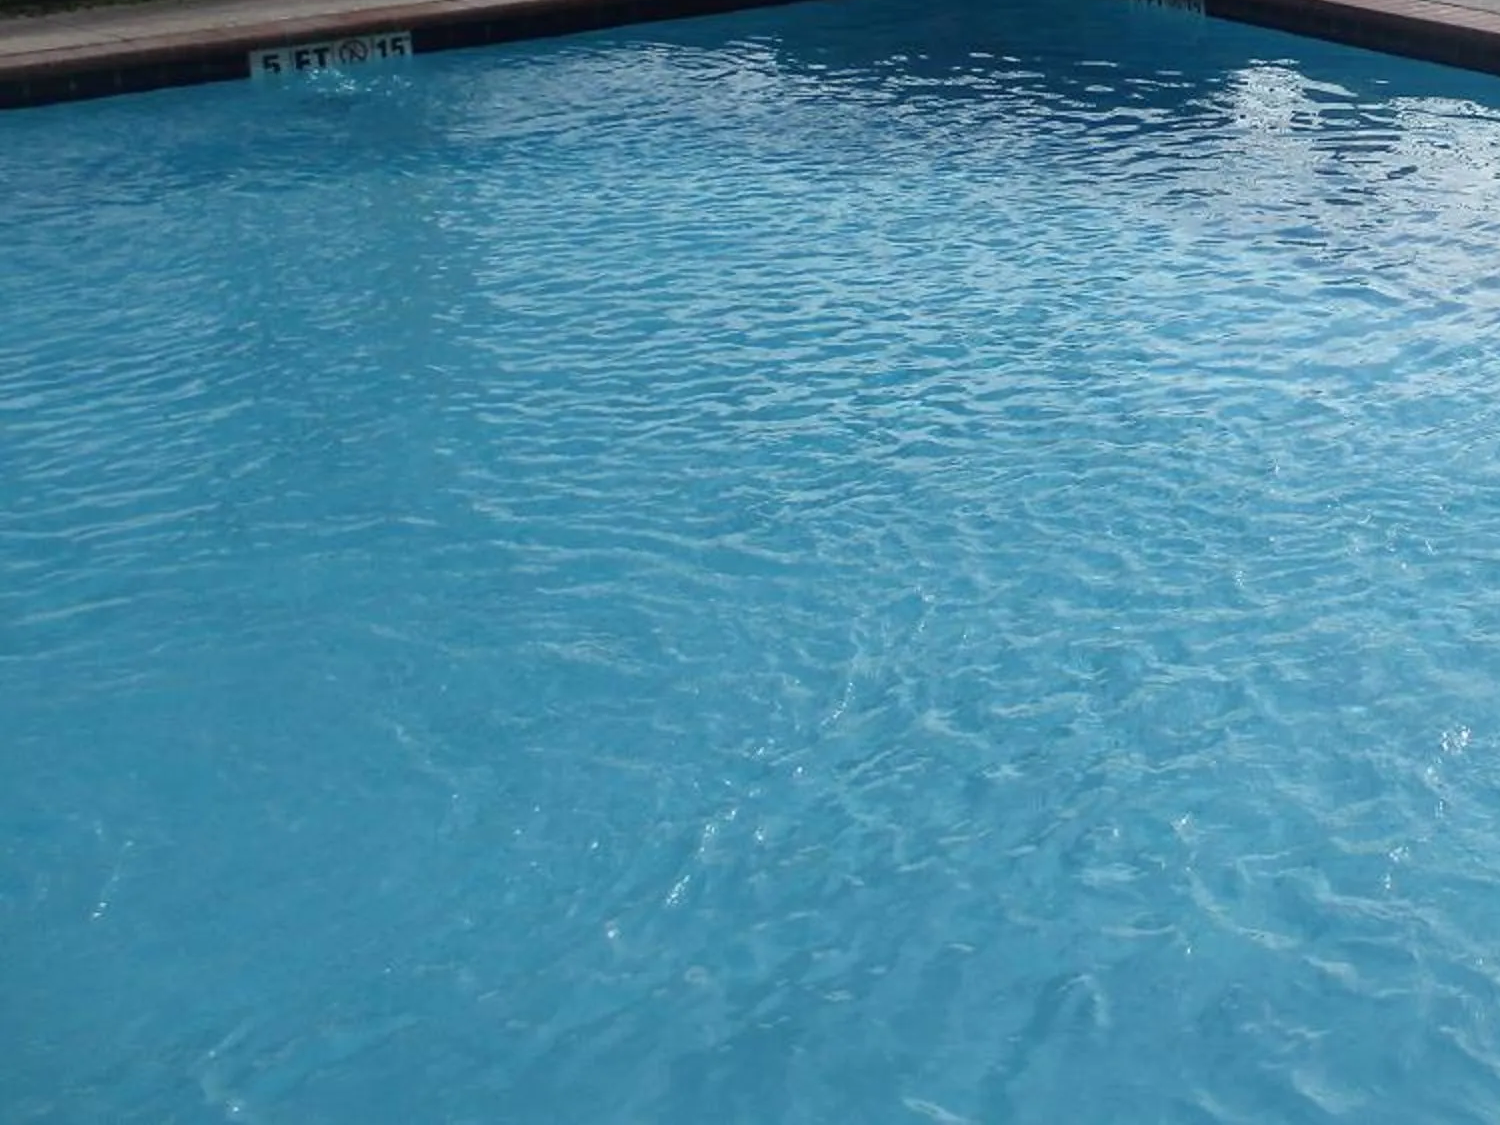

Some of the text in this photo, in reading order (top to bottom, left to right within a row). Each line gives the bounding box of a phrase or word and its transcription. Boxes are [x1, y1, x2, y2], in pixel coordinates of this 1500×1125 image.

[263, 38, 405, 74] 5 FT 15
